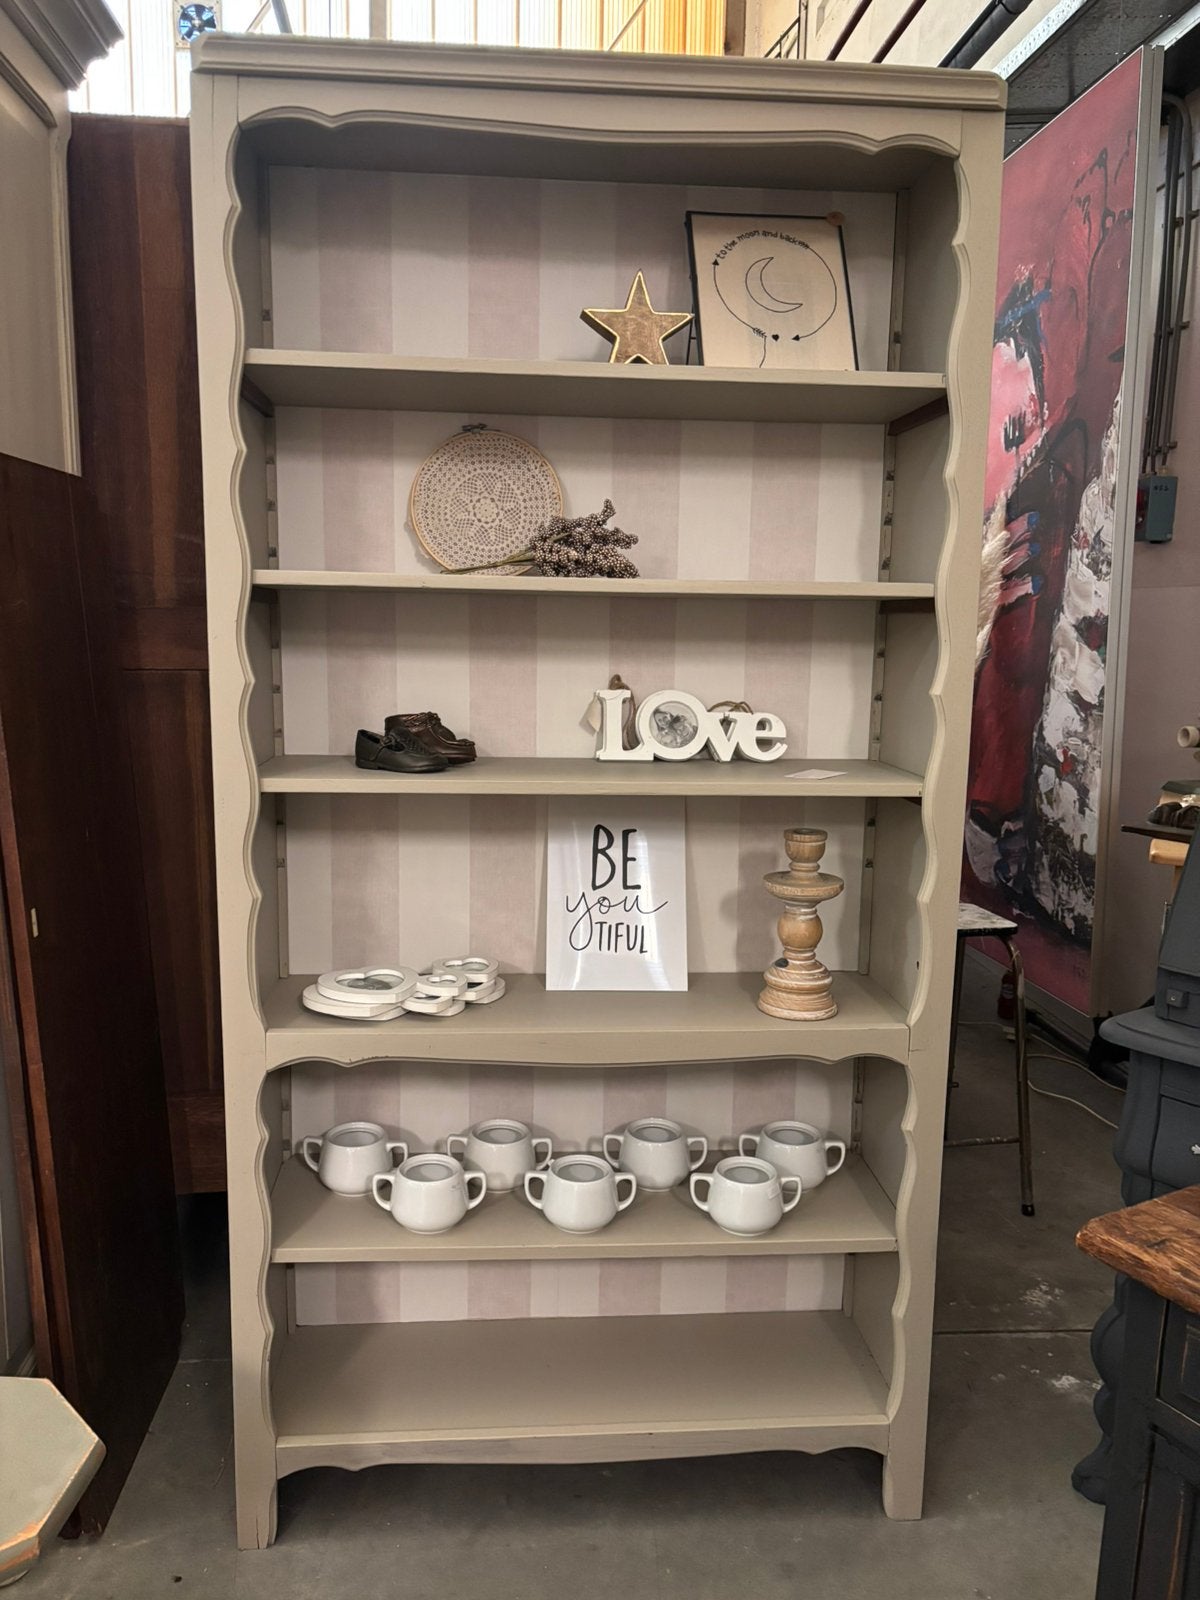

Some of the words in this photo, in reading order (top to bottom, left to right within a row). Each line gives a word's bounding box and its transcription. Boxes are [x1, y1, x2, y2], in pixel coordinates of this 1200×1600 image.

[715, 249, 728, 259] to
[725, 240, 737, 251] the
[736, 230, 760, 241] moon
[761, 230, 778, 239] and
[779, 232, 799, 245] back
[592, 824, 642, 891] BE
[565, 891, 669, 951] you
[595, 921, 648, 954] TIFUL
